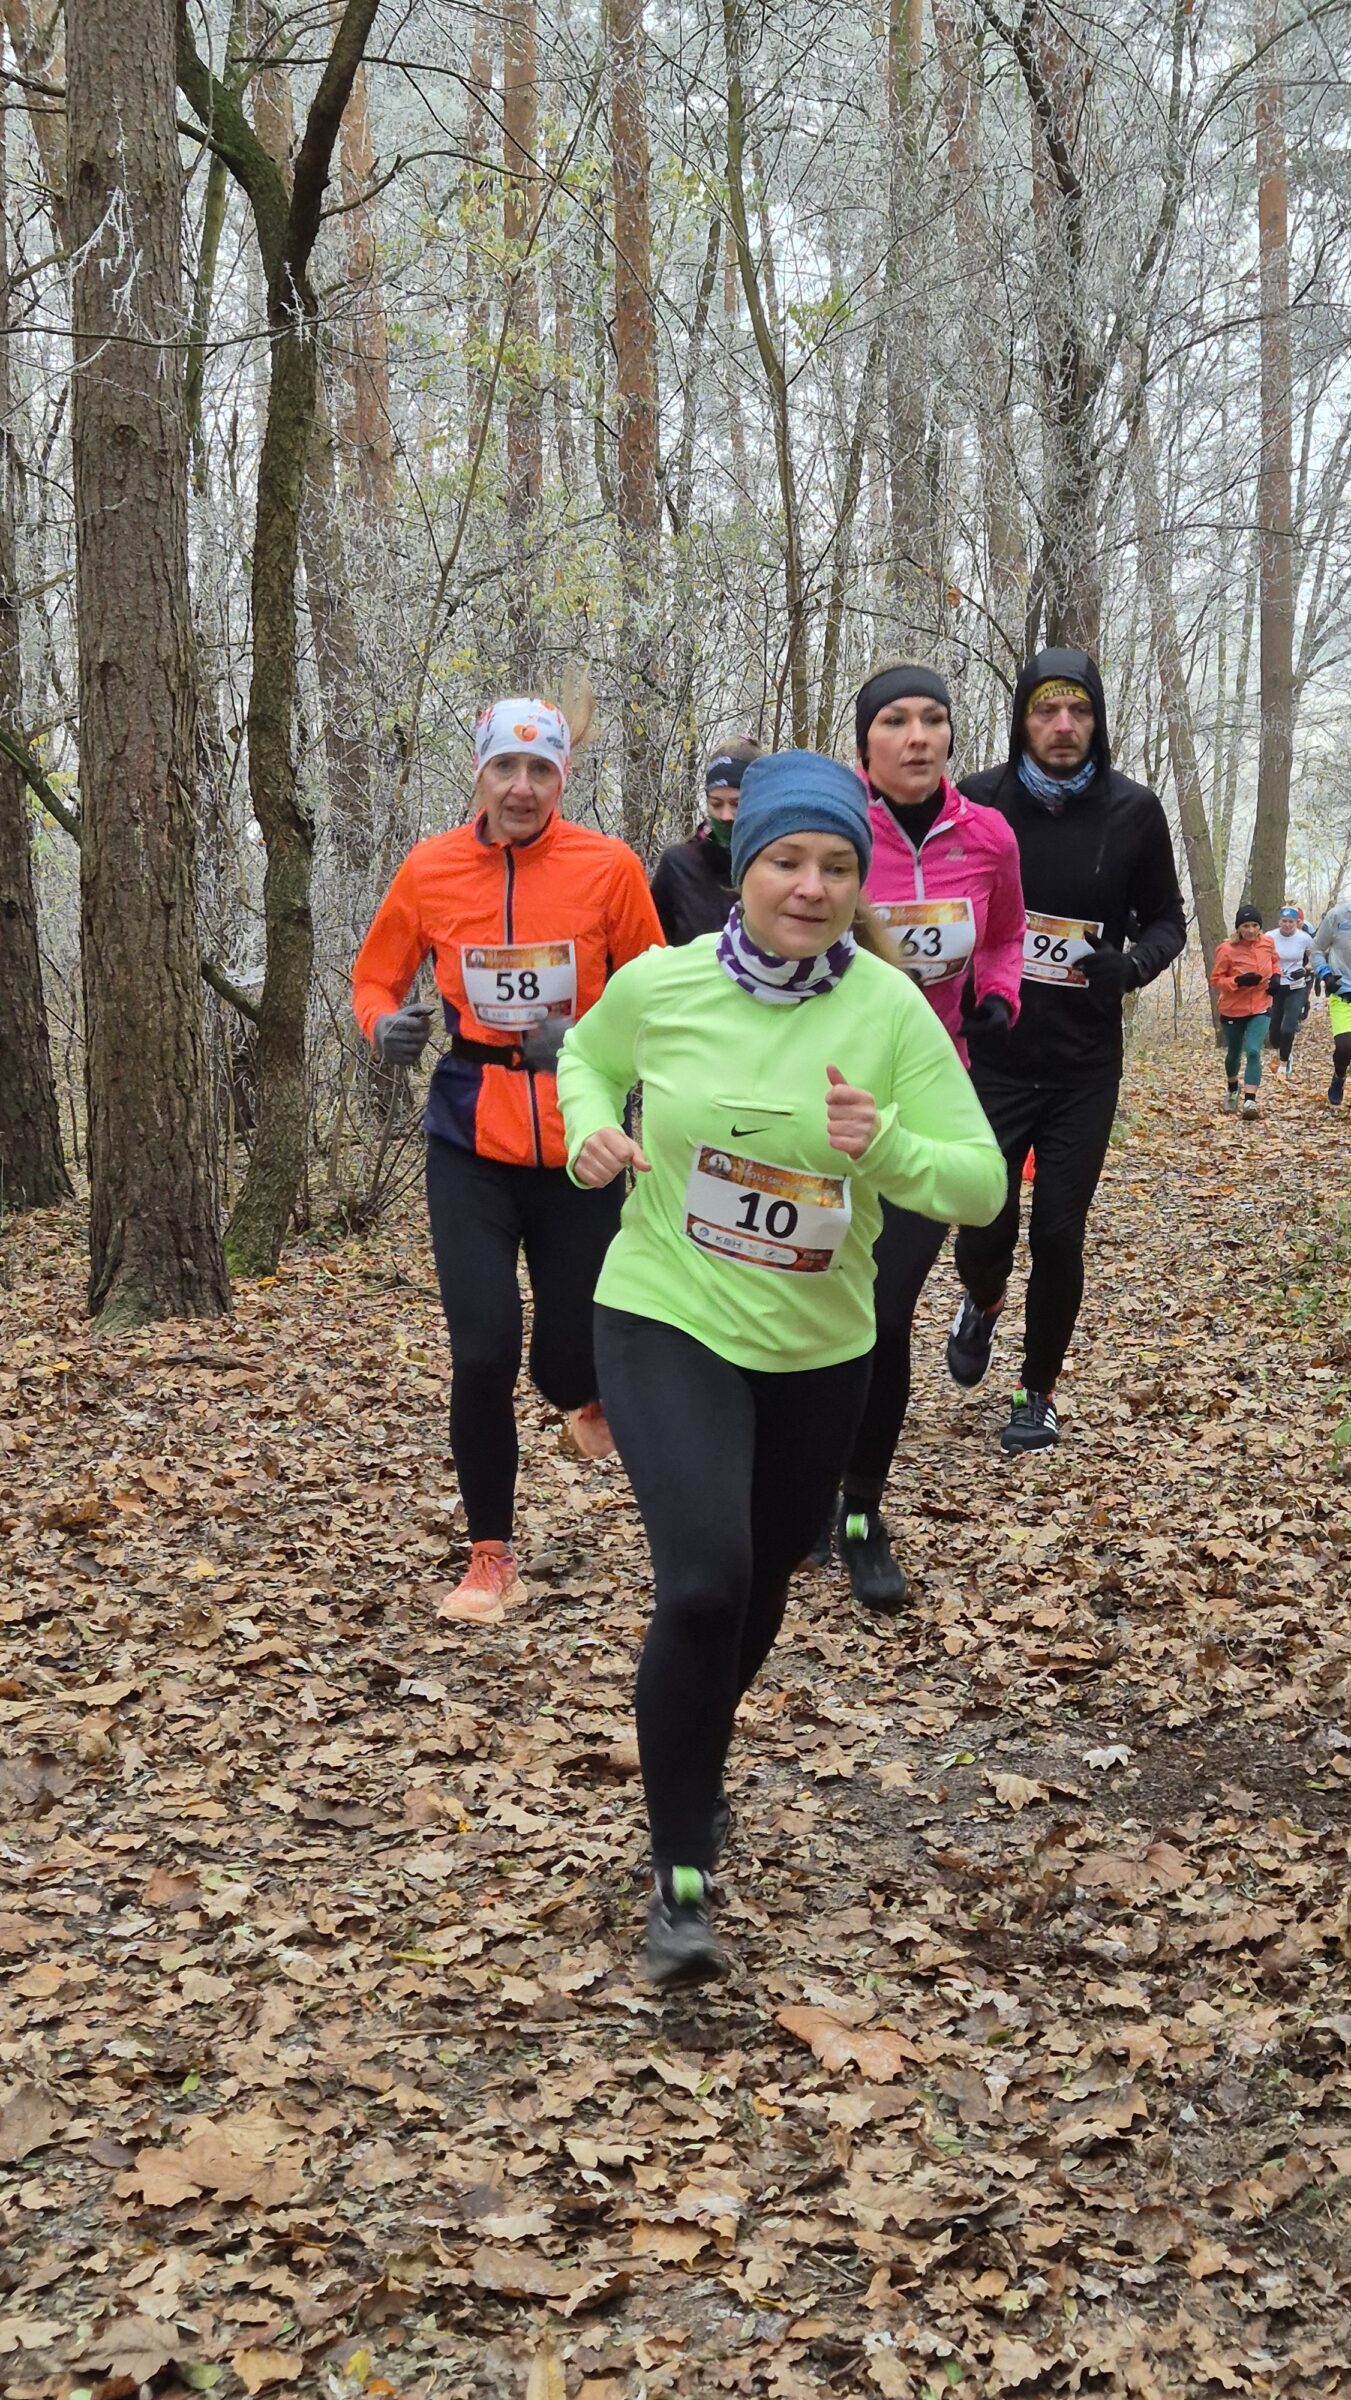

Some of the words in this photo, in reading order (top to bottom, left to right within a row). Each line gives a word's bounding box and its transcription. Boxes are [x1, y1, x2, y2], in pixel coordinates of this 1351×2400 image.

[899, 927, 942, 957] 63
[1033, 934, 1069, 962] 96
[496, 971, 540, 1001] 58
[735, 1192, 798, 1239] 10
